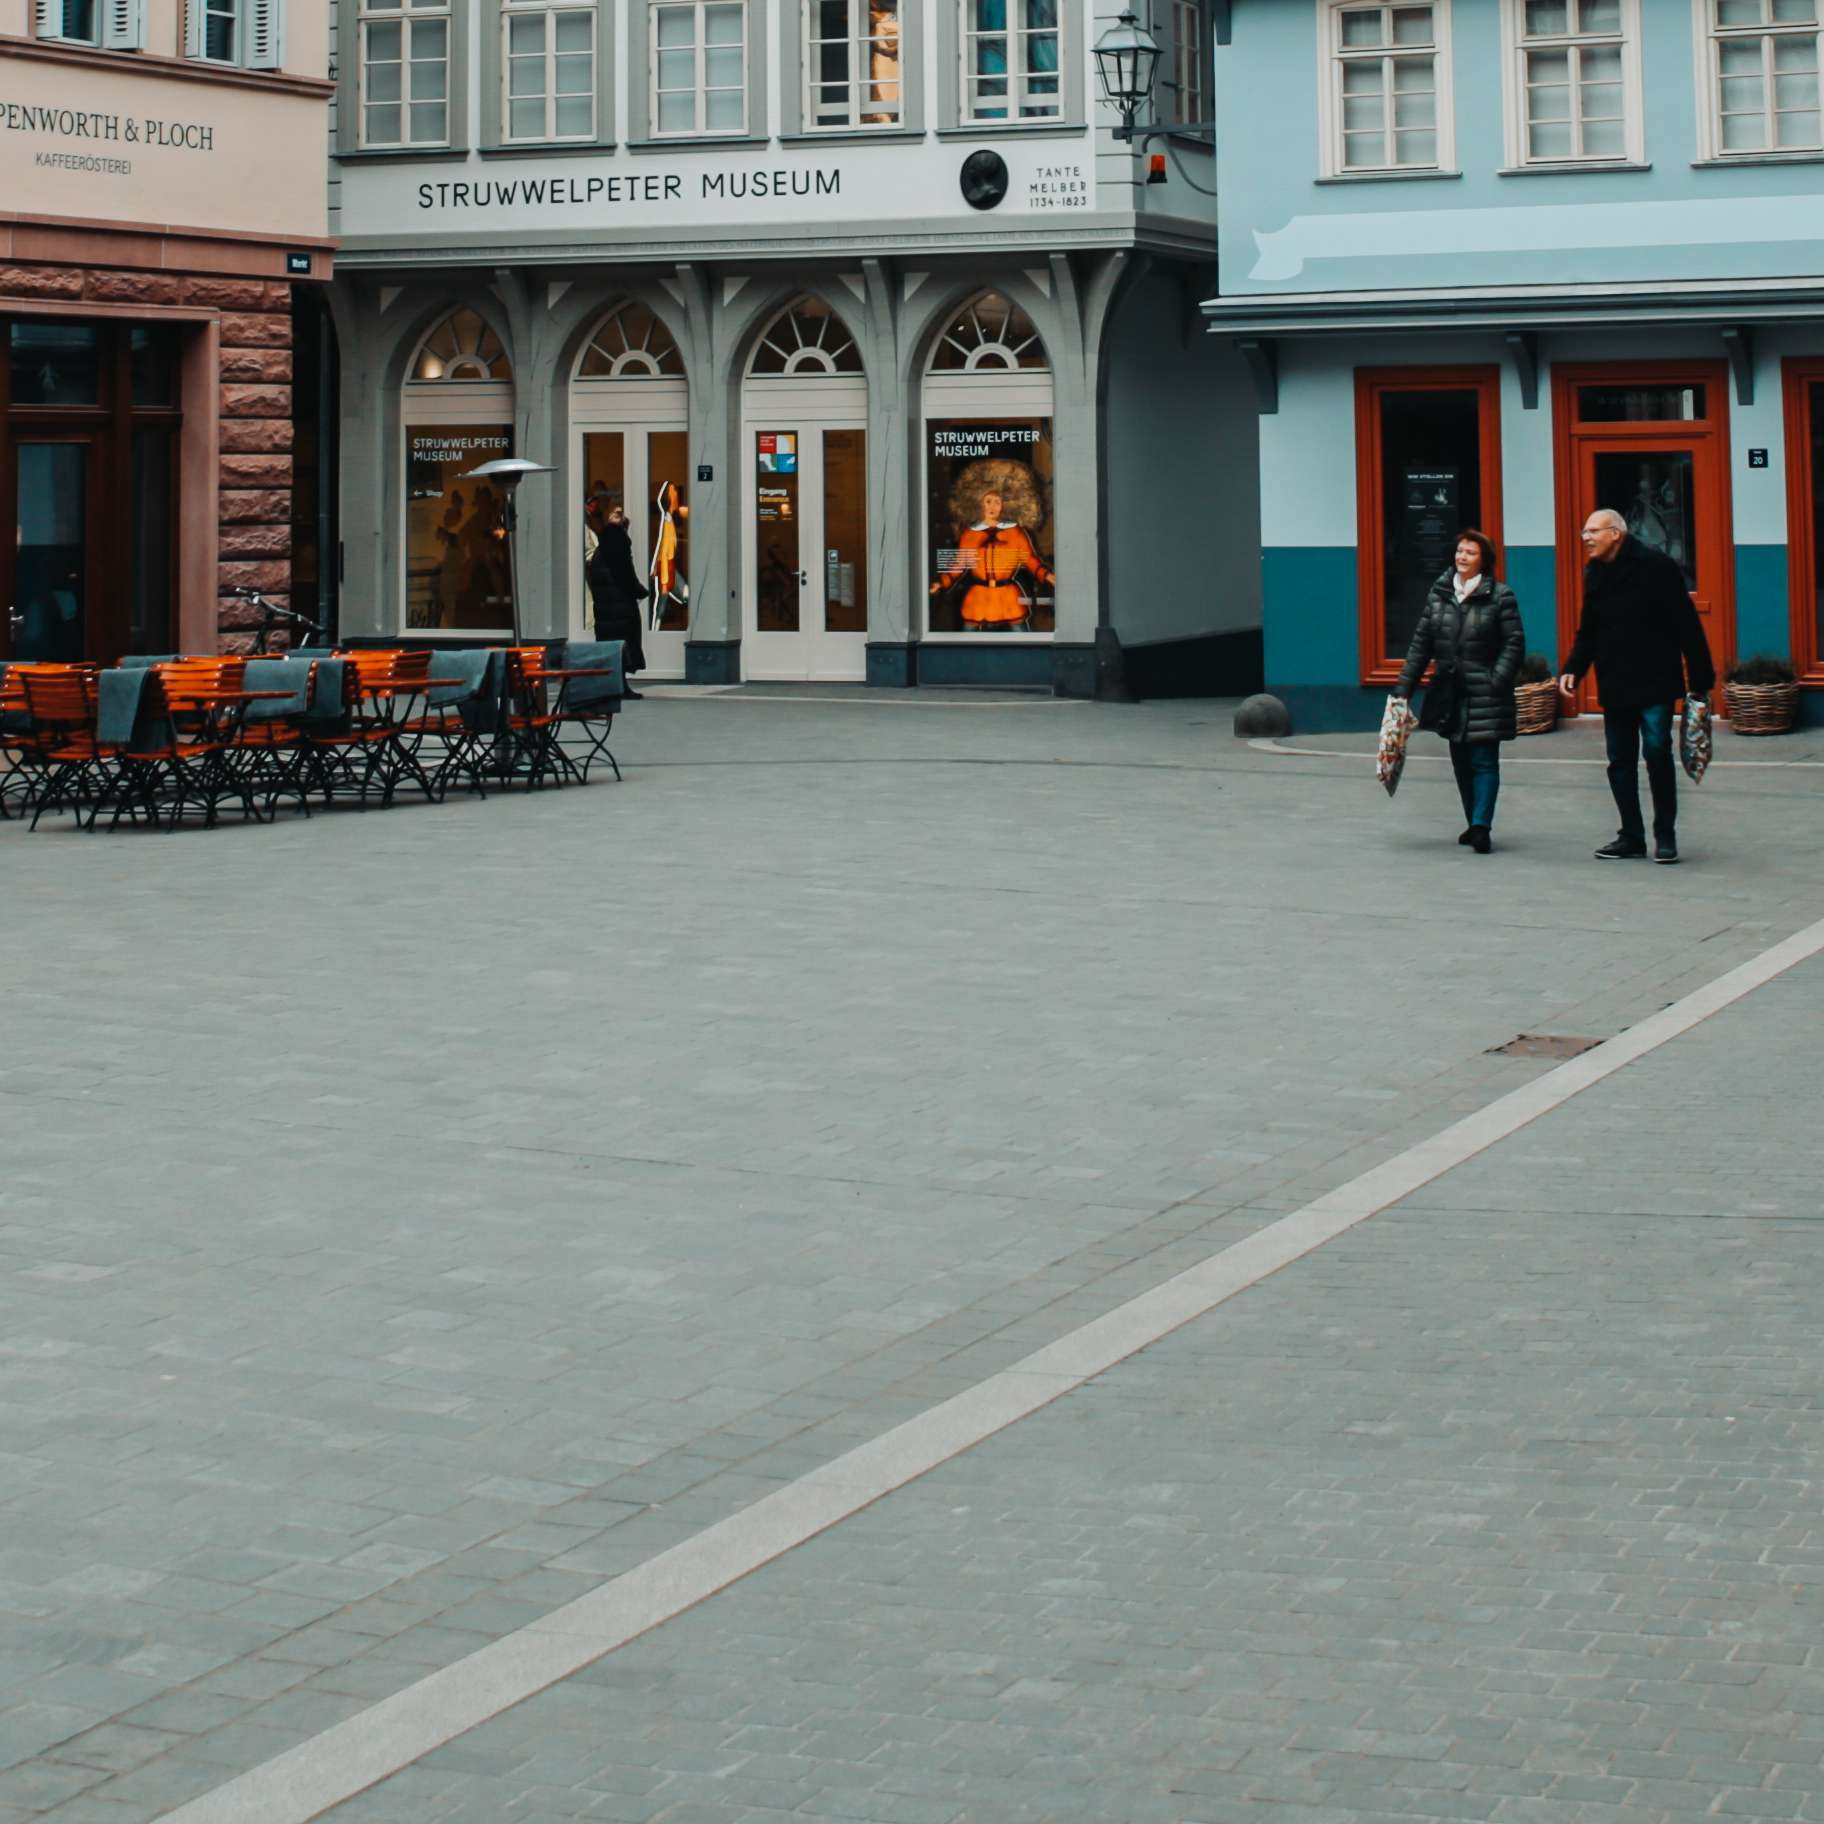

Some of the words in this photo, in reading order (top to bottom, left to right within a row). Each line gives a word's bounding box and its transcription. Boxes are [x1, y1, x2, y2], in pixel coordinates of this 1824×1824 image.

[125, 118, 139, 142] &
[146, 120, 213, 150] PLOCH
[36, 152, 131, 174] KAFFEERÖSTEREI
[1037, 166, 1080, 177] TANTE
[418, 175, 681, 208] STRUWWELPETER
[702, 169, 840, 198] MUSEUM
[1030, 180, 1087, 193] MELBER
[1030, 196, 1087, 208] 1734-1823
[935, 431, 1040, 443] STRUWWELPETER
[413, 438, 509, 449] STRUWWELPETER
[413, 451, 463, 462] MUSEUM
[935, 445, 989, 457] MUSEUM
[1753, 456, 1763, 465] 20
